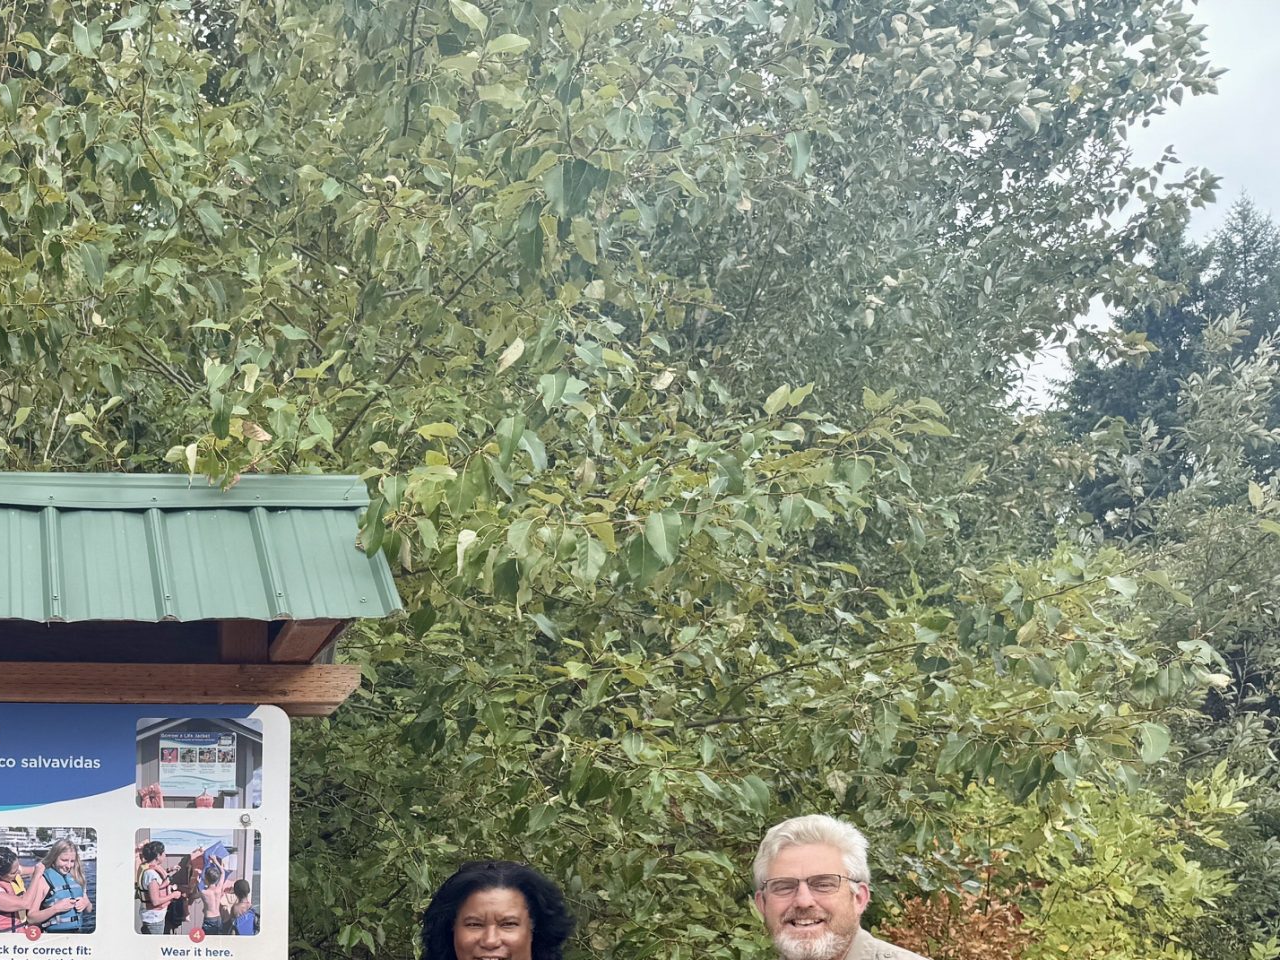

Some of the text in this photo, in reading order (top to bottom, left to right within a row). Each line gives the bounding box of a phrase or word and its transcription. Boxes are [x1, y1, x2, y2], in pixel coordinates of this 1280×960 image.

[21, 755, 101, 769] salvavidas
[30, 929, 37, 938] 3
[193, 931, 200, 939] 4
[12, 945, 29, 954] for
[32, 946, 72, 955] correct
[76, 946, 92, 955] fit:
[160, 947, 233, 957] Wear it here.
